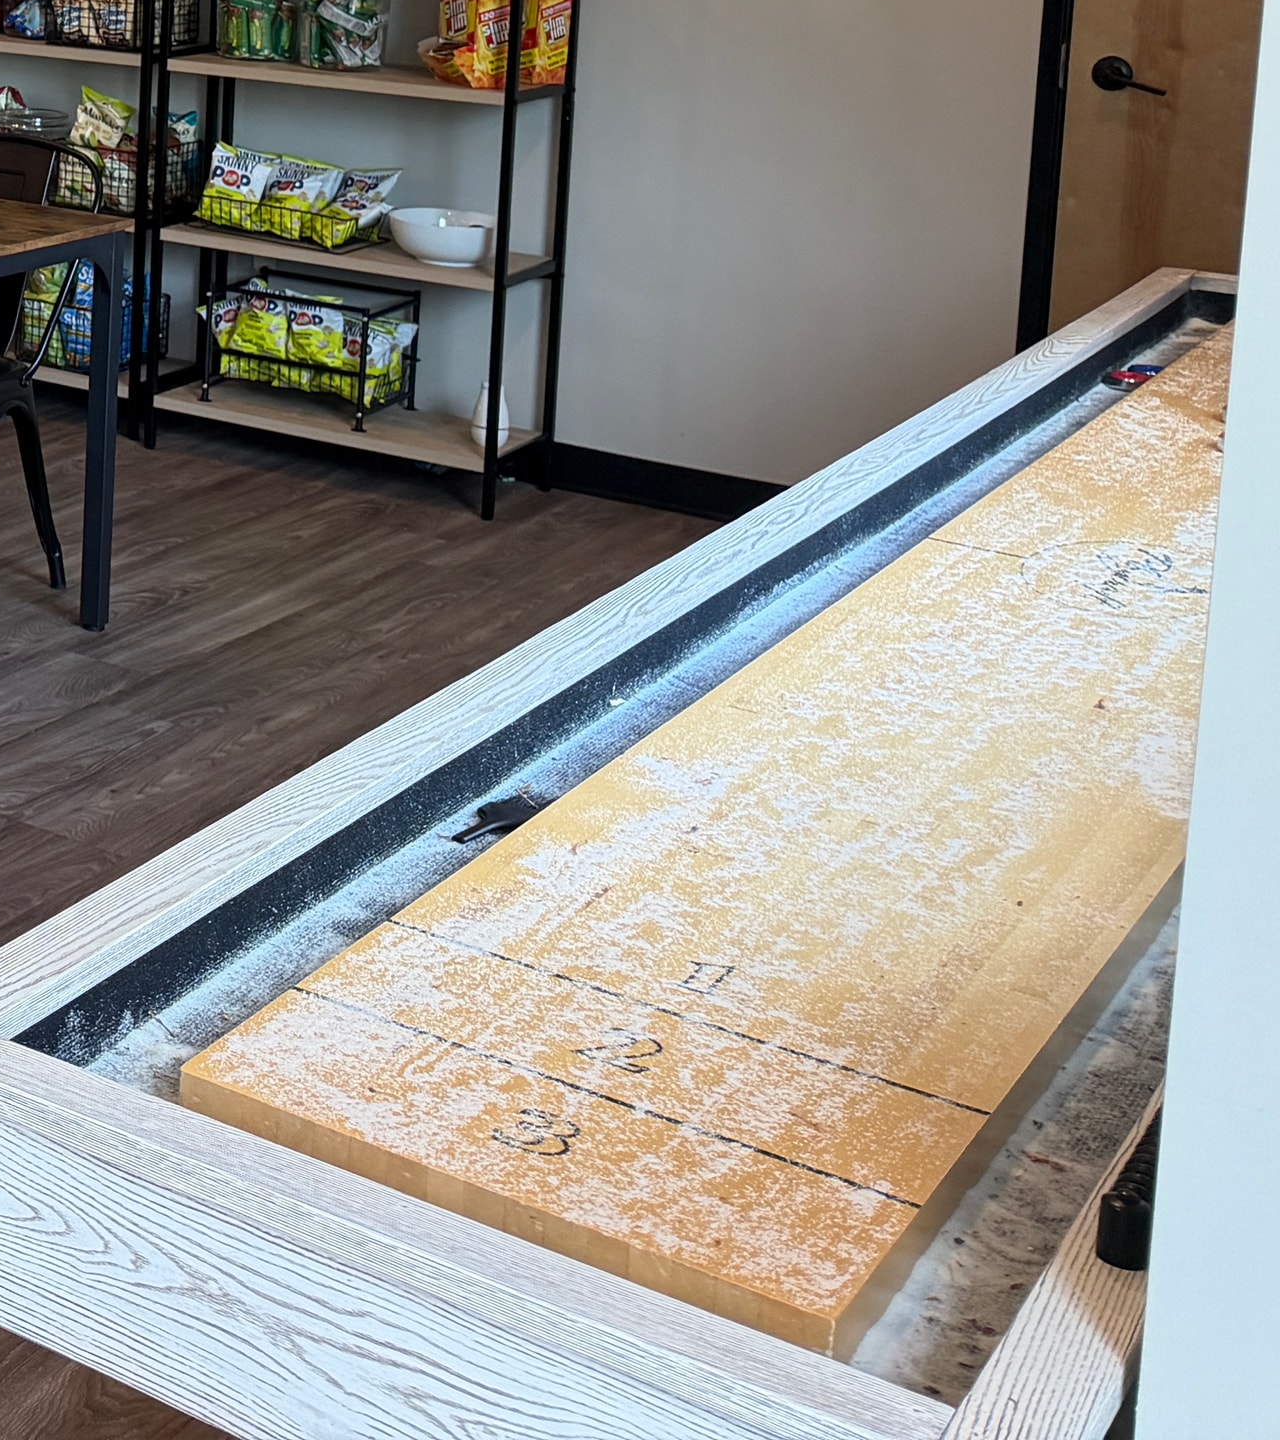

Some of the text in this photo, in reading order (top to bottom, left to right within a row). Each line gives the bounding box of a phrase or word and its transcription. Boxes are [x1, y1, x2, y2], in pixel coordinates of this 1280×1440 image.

[217, 154, 258, 175] SKINNY
[275, 166, 310, 181] SKINNY
[211, 164, 252, 189] POP
[268, 179, 304, 193] POP
[343, 175, 379, 193] POP
[289, 310, 324, 327] POP
[571, 1026, 663, 1074] 2
[491, 1107, 582, 1156] 3
